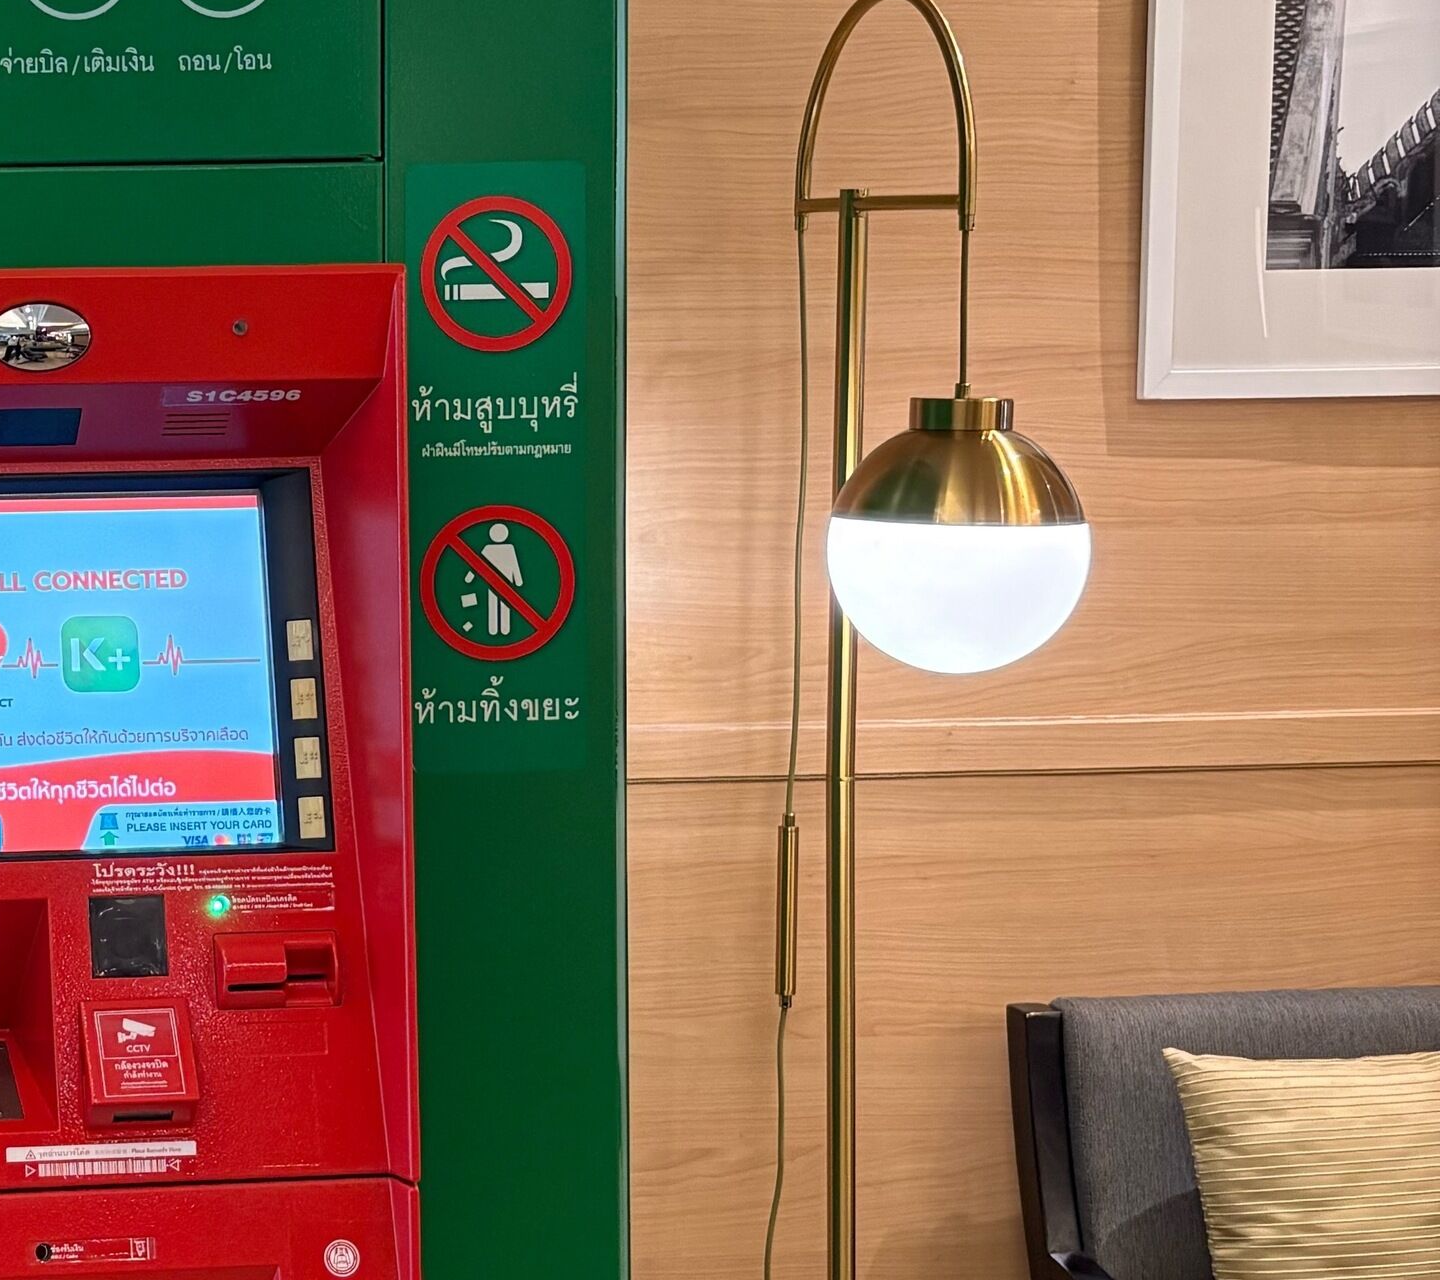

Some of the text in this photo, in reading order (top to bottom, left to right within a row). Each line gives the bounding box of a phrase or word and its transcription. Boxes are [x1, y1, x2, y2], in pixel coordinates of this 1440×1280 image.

[186, 389, 302, 402] S1C4596
[411, 372, 579, 434] ห้ามสูบบุหรี่
[32, 568, 188, 591] CONNECTED
[70, 637, 131, 672] K+
[414, 675, 580, 724] ห้ามทิ้งขยะ
[126, 819, 272, 832] PLEASE INSERT YOUR CARD
[182, 835, 209, 846] VISA
[92, 862, 195, 878] โปรดระวัง!!!
[126, 1044, 151, 1054] CCTV
